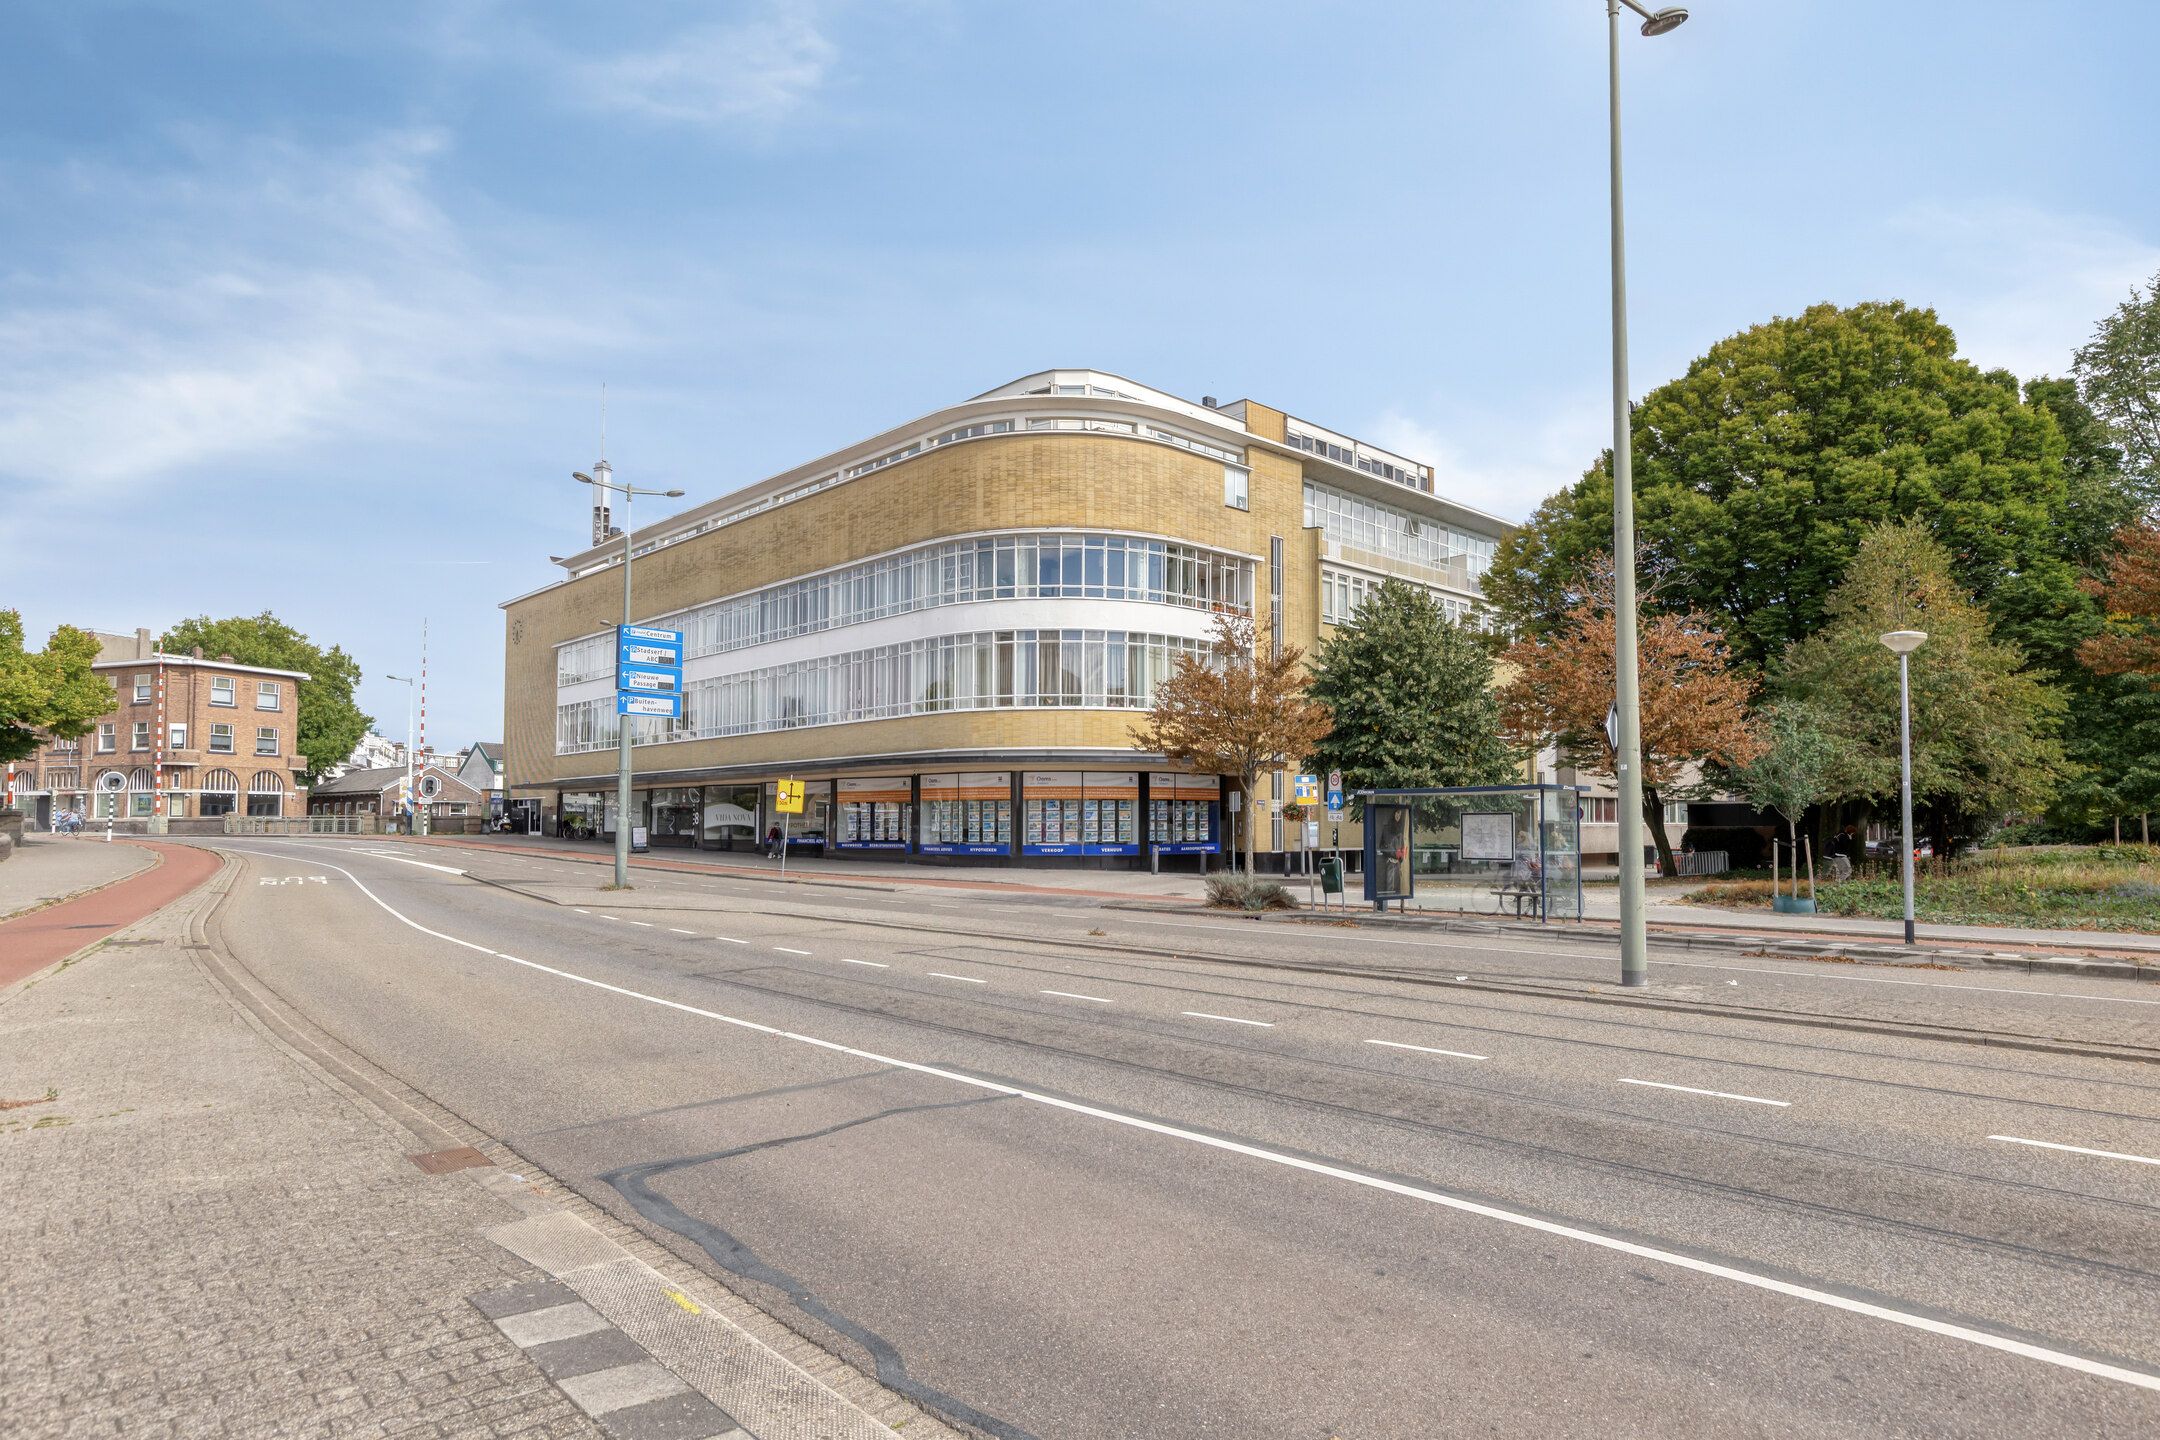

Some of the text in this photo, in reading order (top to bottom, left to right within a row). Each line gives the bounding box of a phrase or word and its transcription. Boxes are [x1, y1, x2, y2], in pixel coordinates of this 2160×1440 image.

[646, 631, 672, 639] Centrum
[637, 647, 663, 655] Stadserf
[633, 680, 656, 688] Passage
[642, 706, 672, 714] havenweg
